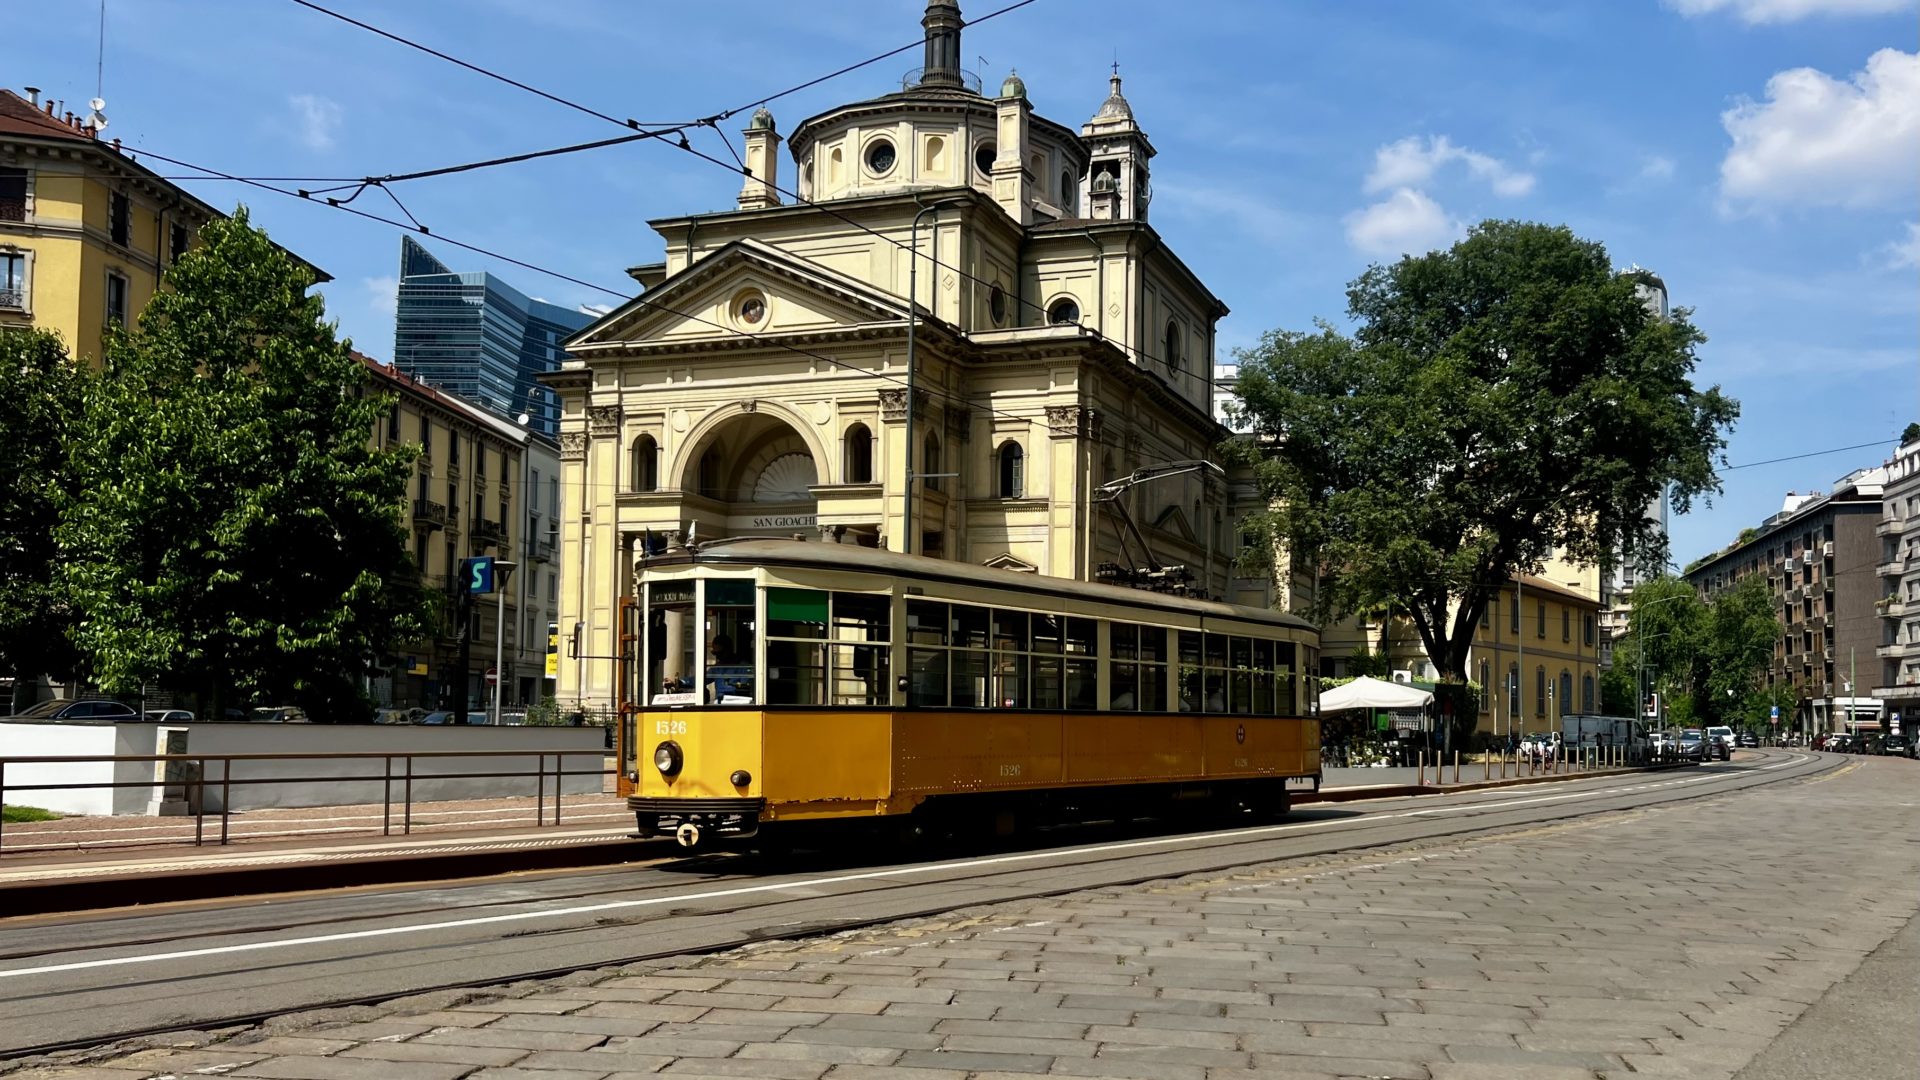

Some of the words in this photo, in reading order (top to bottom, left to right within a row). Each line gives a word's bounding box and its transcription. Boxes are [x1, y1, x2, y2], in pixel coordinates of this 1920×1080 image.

[753, 517, 772, 527] SAN
[775, 516, 815, 526] GIOACHI
[471, 562, 486, 588] S
[1892, 712, 1898, 720] P
[656, 720, 686, 735] 1526
[1000, 764, 1021, 776] 1526
